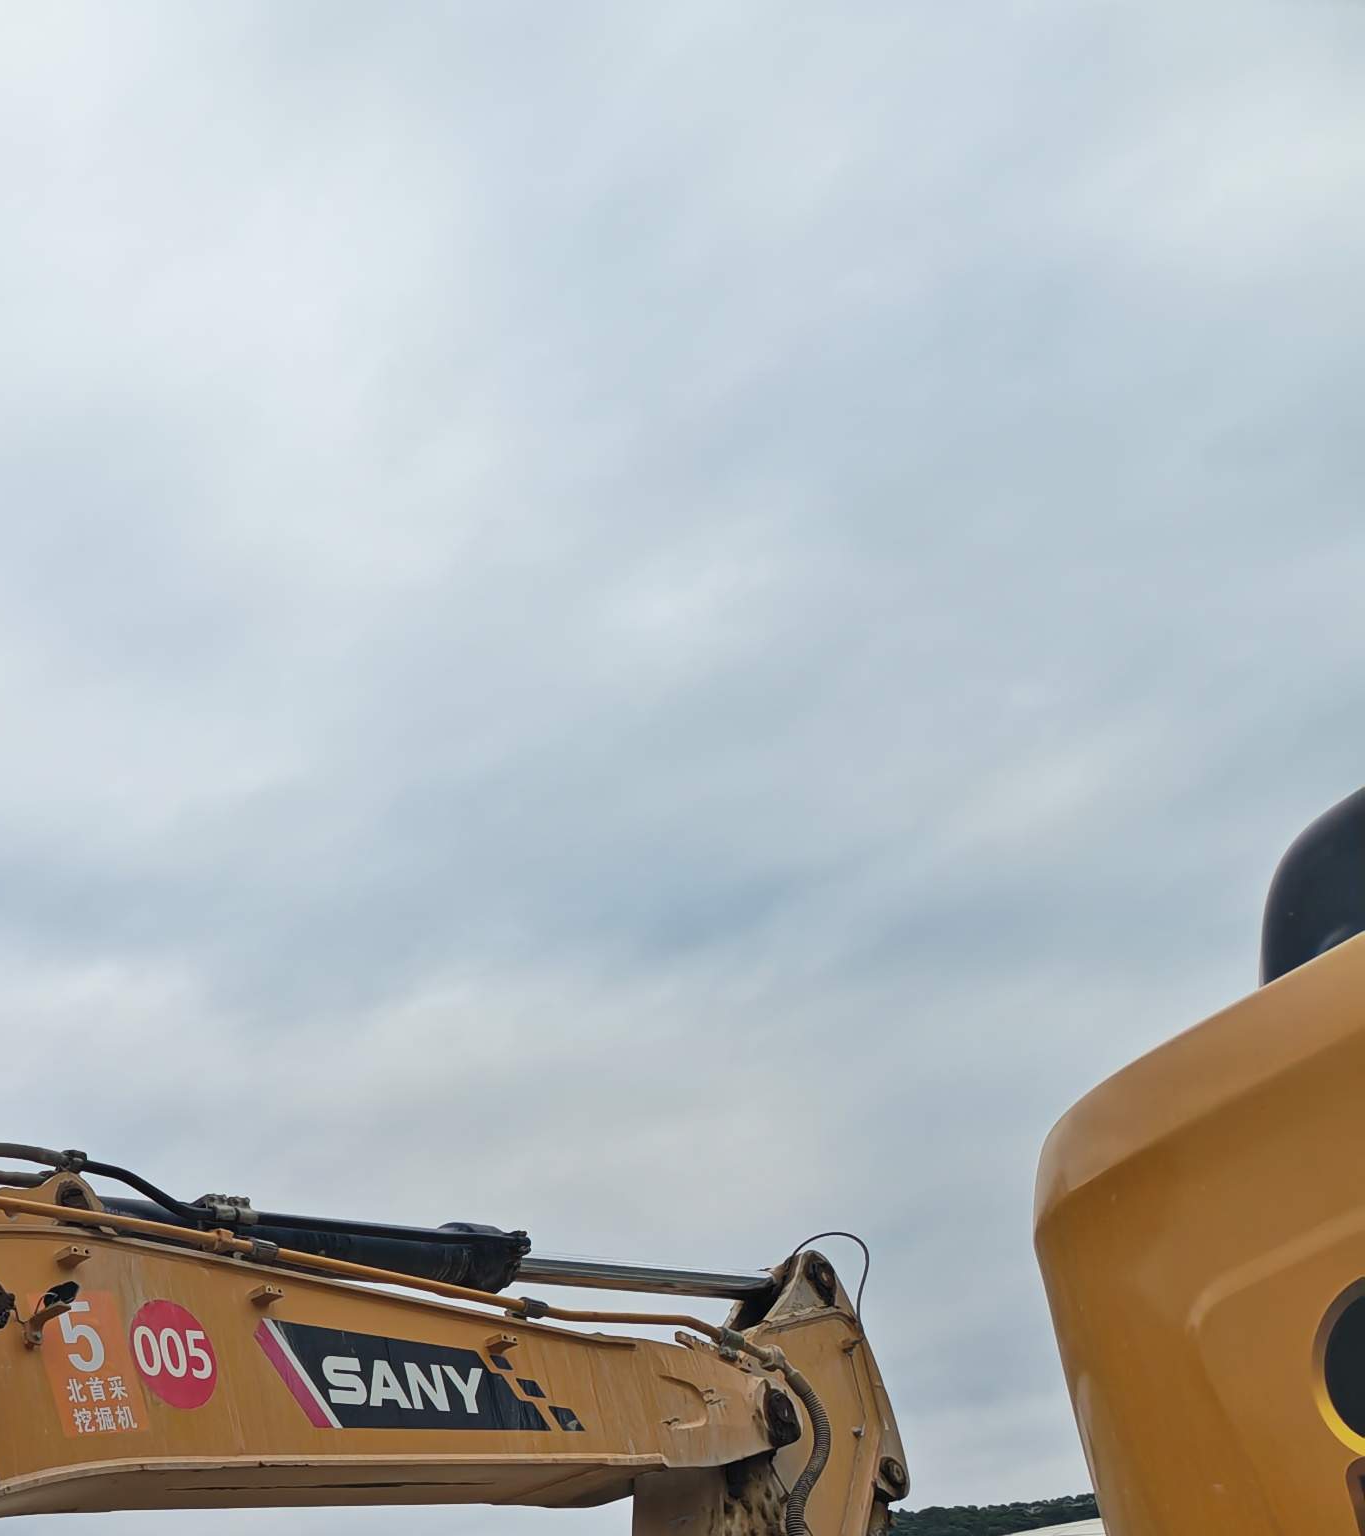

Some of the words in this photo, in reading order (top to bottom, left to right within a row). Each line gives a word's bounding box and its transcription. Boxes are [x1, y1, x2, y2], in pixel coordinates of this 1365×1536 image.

[58, 1301, 105, 1372] 5
[133, 1325, 213, 1380] 005
[66, 1376, 128, 1403] 北首采
[321, 1355, 484, 1414] SANY
[73, 1406, 138, 1433] 挖掘机
